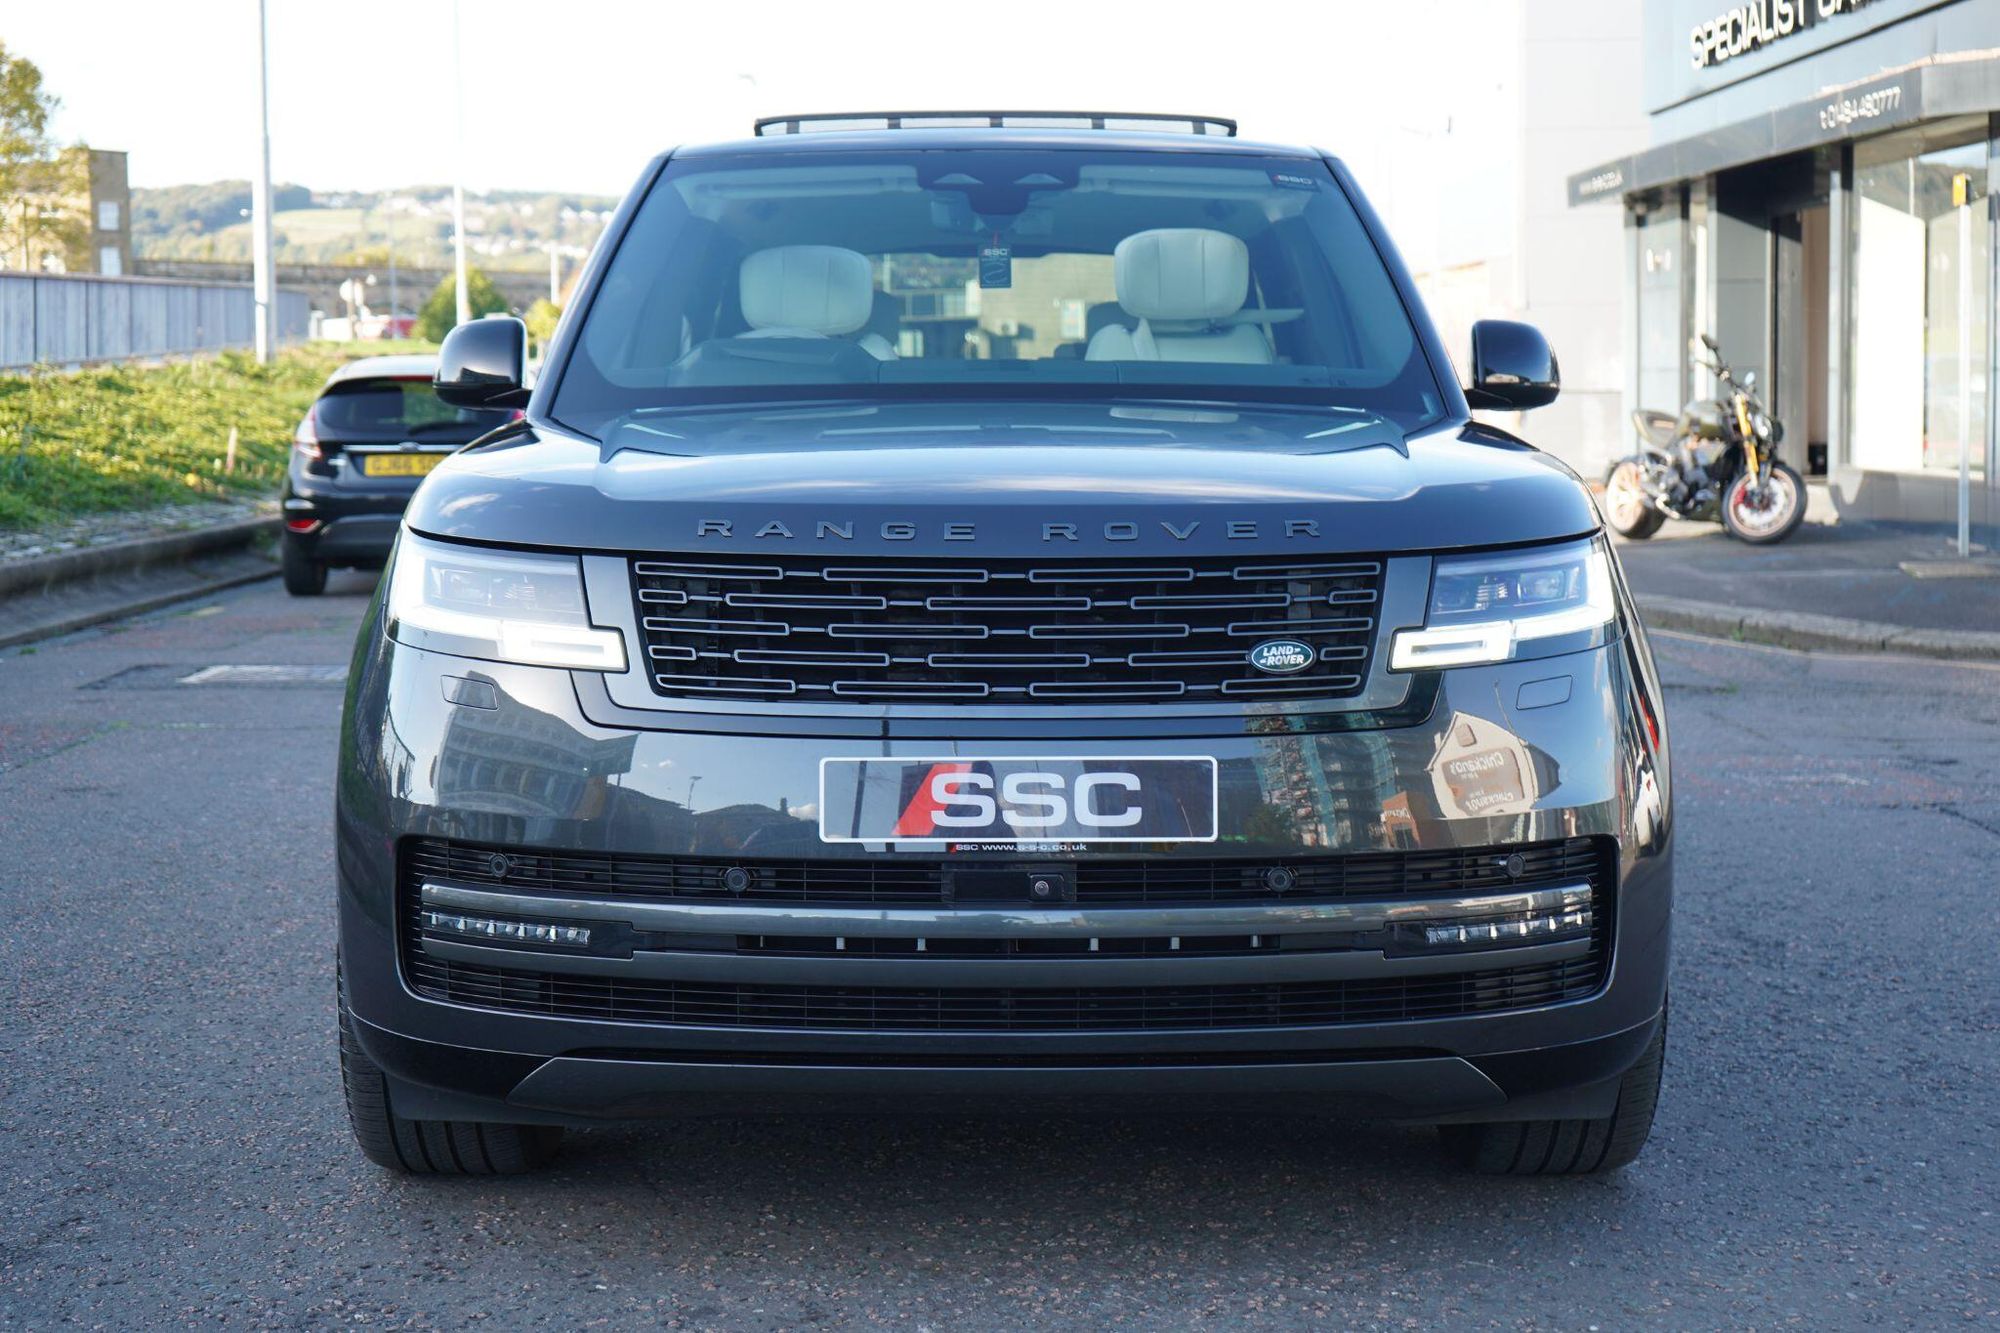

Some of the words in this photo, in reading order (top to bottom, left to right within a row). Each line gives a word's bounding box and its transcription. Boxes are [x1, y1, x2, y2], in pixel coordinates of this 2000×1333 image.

[697, 519, 976, 540] RANGE
[1042, 519, 1321, 540] ROVER
[1263, 645, 1293, 656] LAND
[1268, 654, 1304, 666] ROVER
[930, 772, 1142, 828] SSC
[955, 843, 979, 852] SSC
[982, 843, 1087, 851] www.s-s-c.co.uk
